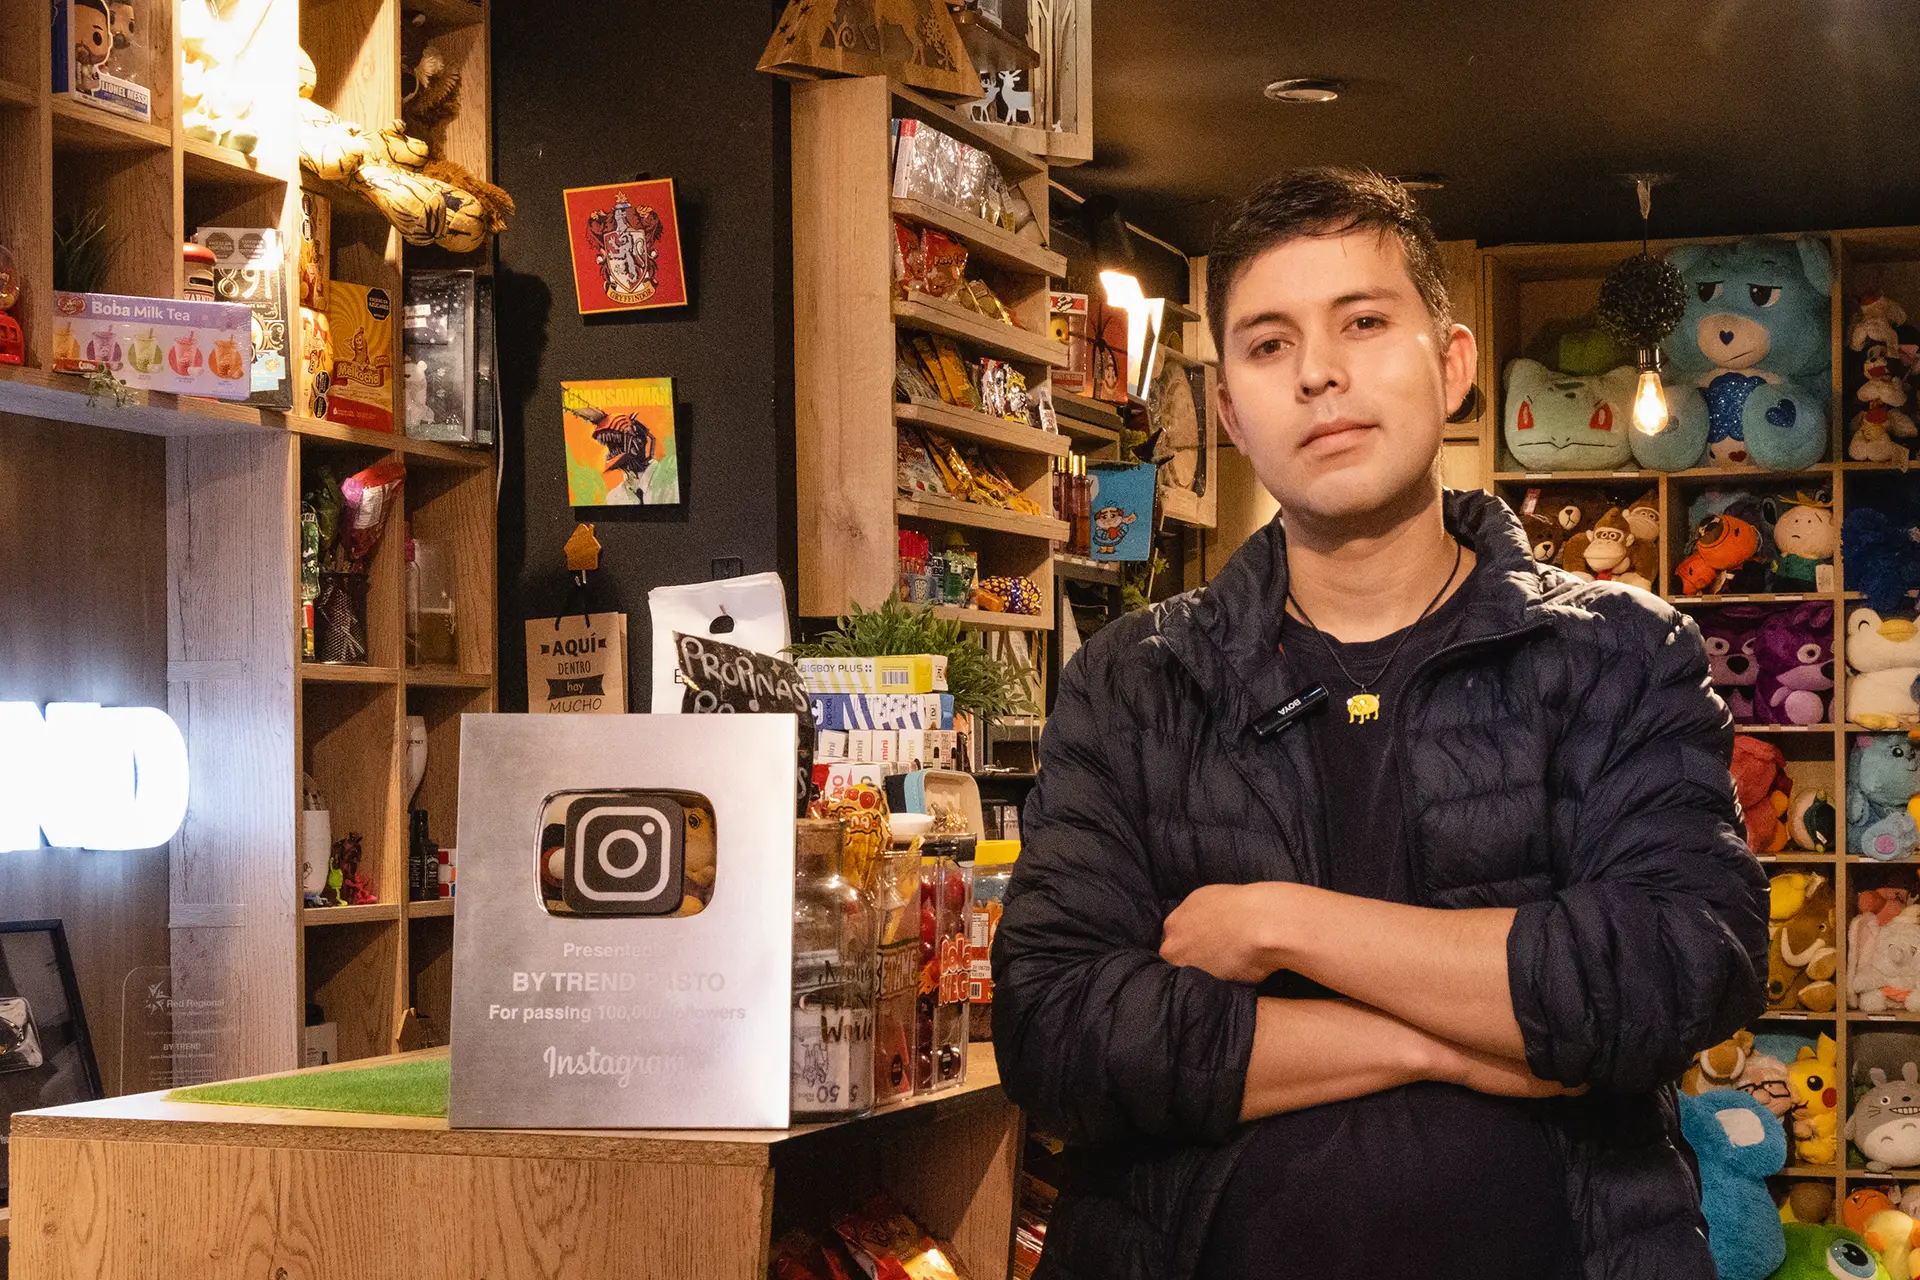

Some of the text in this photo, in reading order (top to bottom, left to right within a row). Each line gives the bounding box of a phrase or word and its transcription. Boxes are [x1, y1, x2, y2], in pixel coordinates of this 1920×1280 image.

[101, 81, 127, 98] LIONEL
[609, 288, 653, 303] GRYFFINDOR
[92, 299, 131, 317] Boba
[133, 305, 164, 320] Milk
[167, 308, 191, 322] Tea
[552, 632, 597, 657] AQUÍ
[558, 660, 592, 676] DENTRO
[800, 664, 864, 673] BIGBOY PLUS
[548, 697, 603, 714] MUCHO
[1277, 698, 1302, 716] BOYA
[881, 740, 889, 761] mini
[512, 971, 726, 993] BY TREND PSTO
[488, 1004, 519, 1021] For
[522, 1004, 592, 1024] passing
[543, 1044, 690, 1088] Instagram
